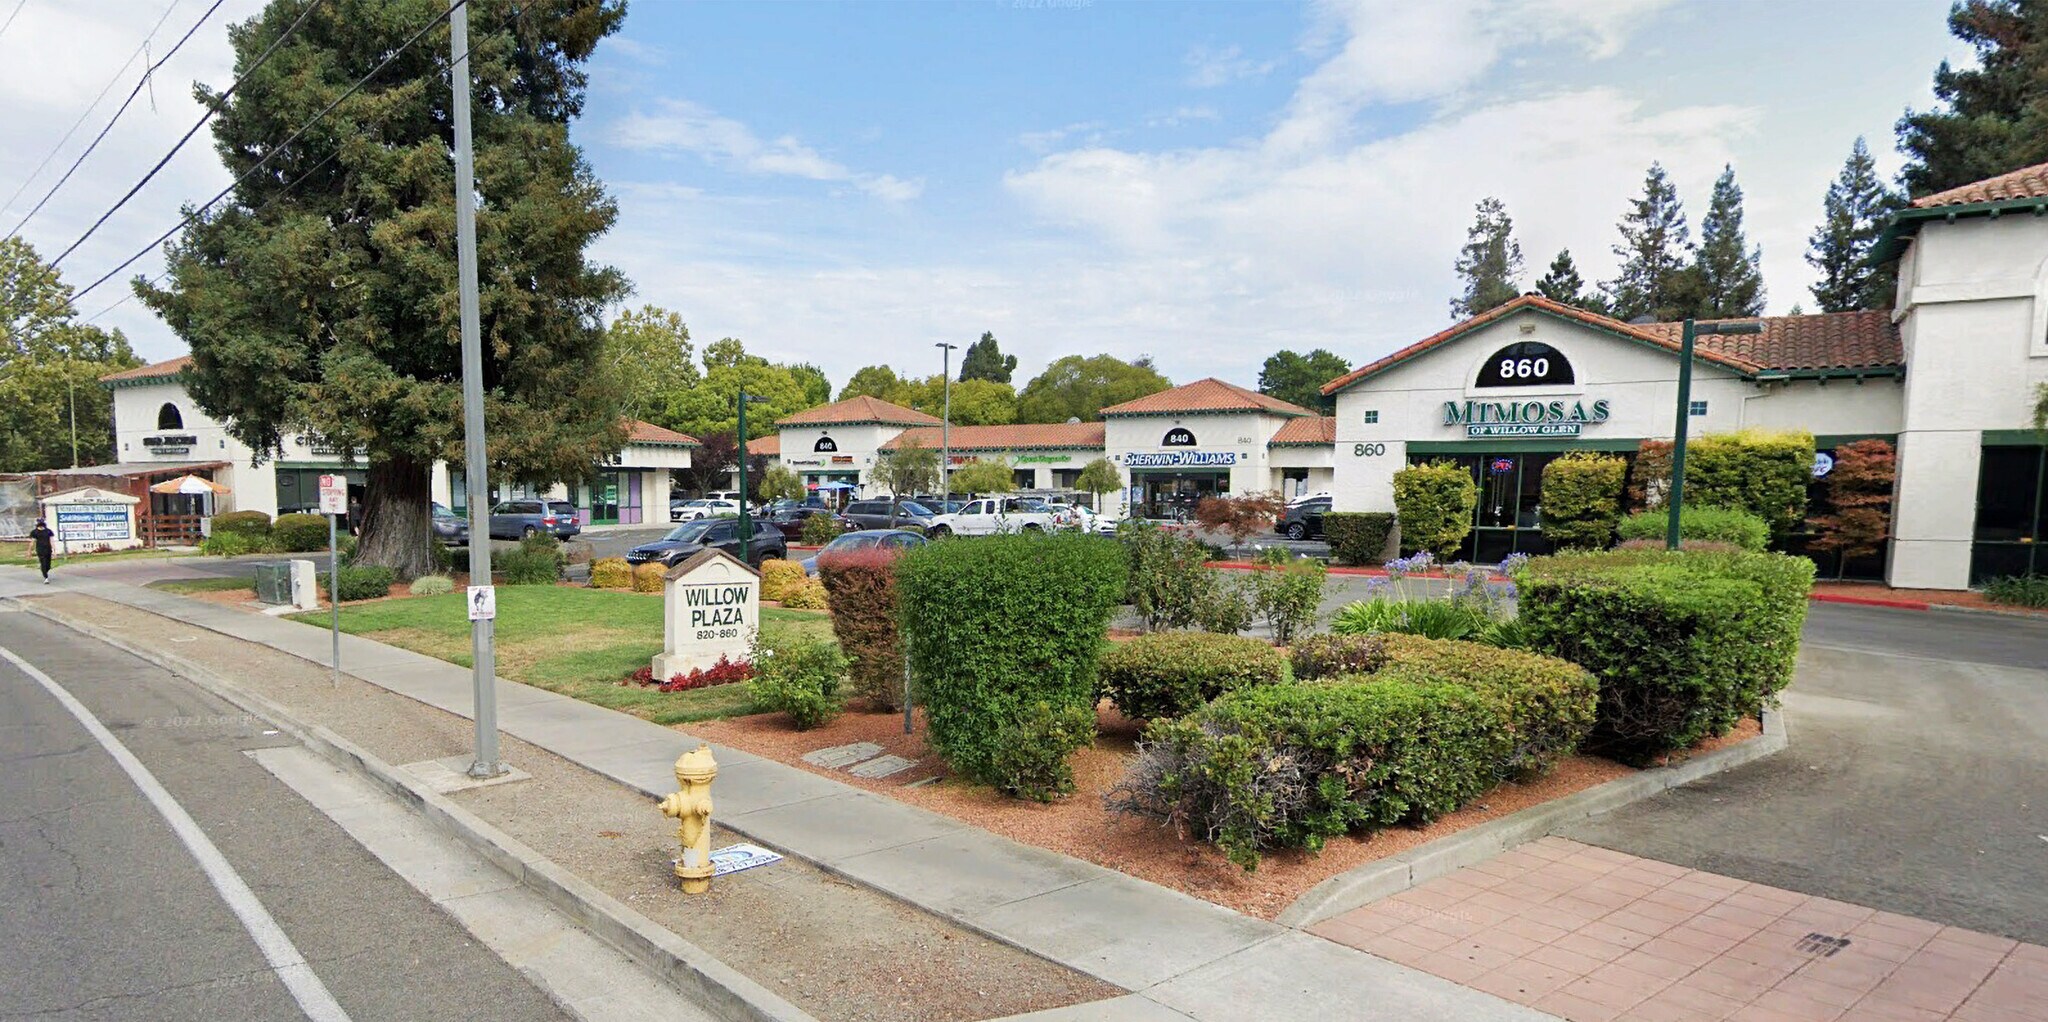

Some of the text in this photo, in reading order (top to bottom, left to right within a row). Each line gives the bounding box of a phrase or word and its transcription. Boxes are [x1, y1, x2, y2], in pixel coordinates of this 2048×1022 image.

[1500, 358, 1549, 378] 860
[1444, 400, 1610, 425] MIMOSAS
[1470, 425, 1577, 435] OF WILLOW GLEN
[1170, 434, 1189, 443] 840
[819, 442, 833, 450] 840
[1354, 443, 1386, 457] 860
[1125, 451, 1236, 466] SHERWIN-WILLIAMS
[686, 587, 749, 607] WILLOW
[692, 608, 744, 628] PLAZA
[696, 628, 738, 640] 820-860
